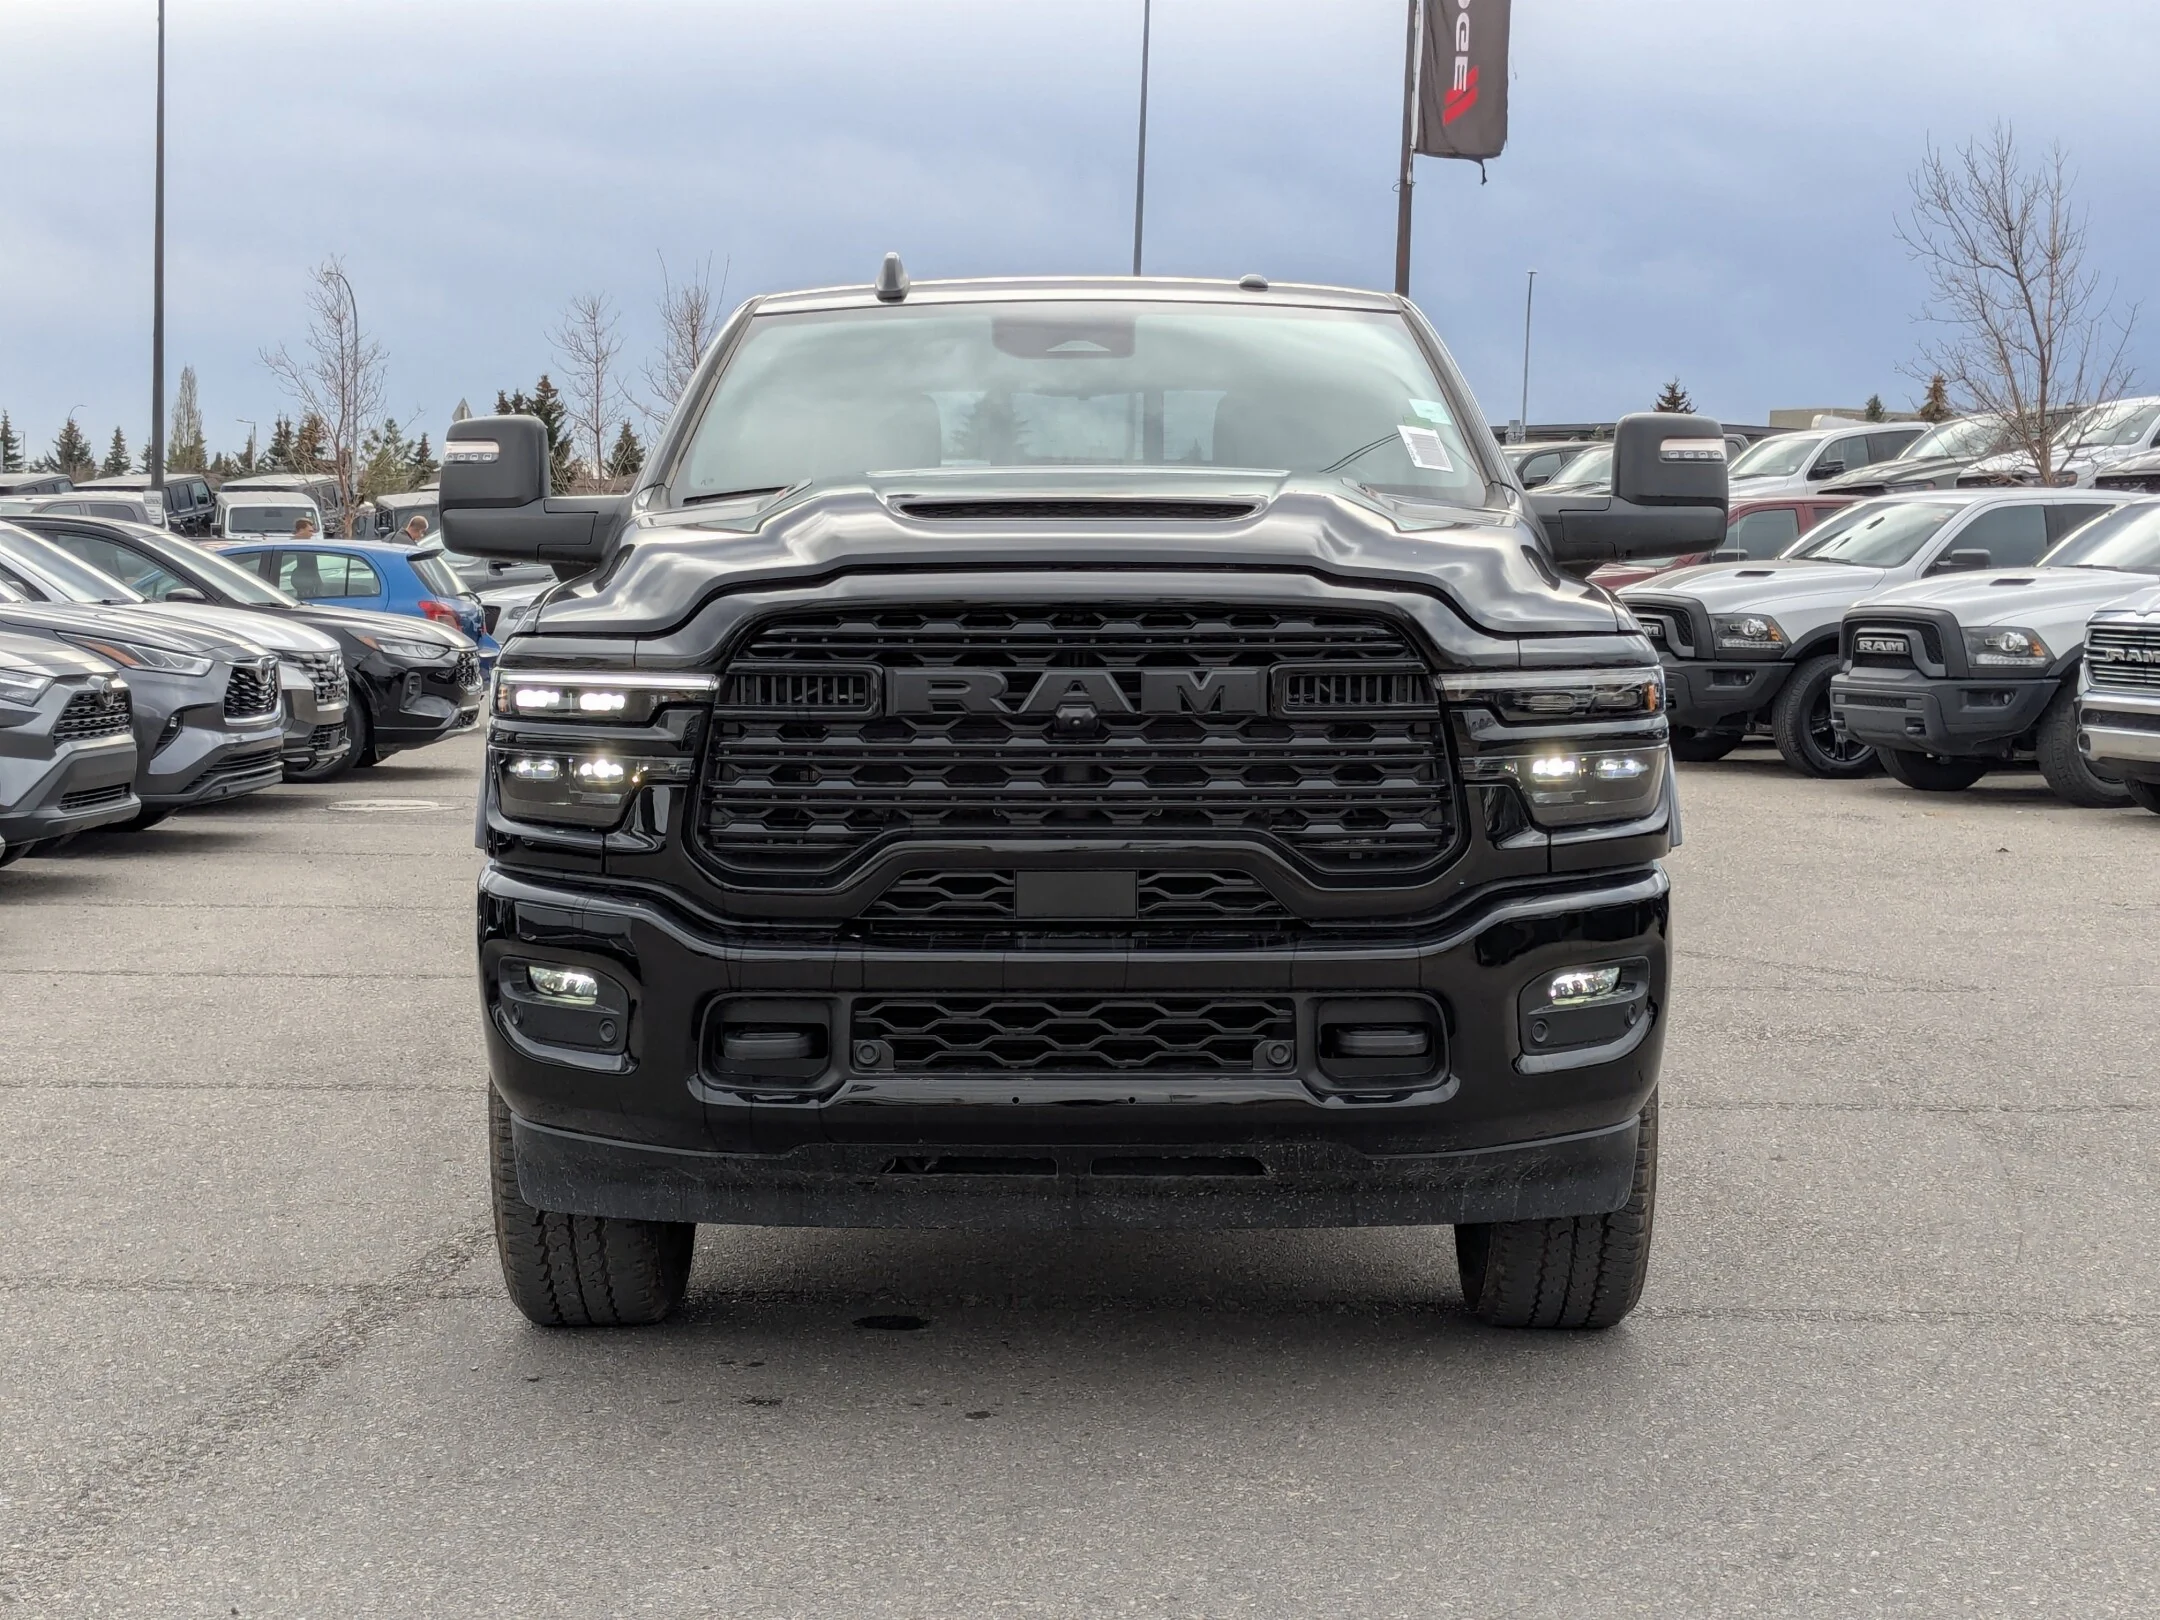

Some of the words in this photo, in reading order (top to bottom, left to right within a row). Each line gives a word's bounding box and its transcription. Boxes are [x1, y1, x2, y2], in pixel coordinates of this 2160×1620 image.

[1453, 0, 1470, 91] GE
[1859, 640, 1905, 651] RAM
[894, 667, 1261, 716] RAM
